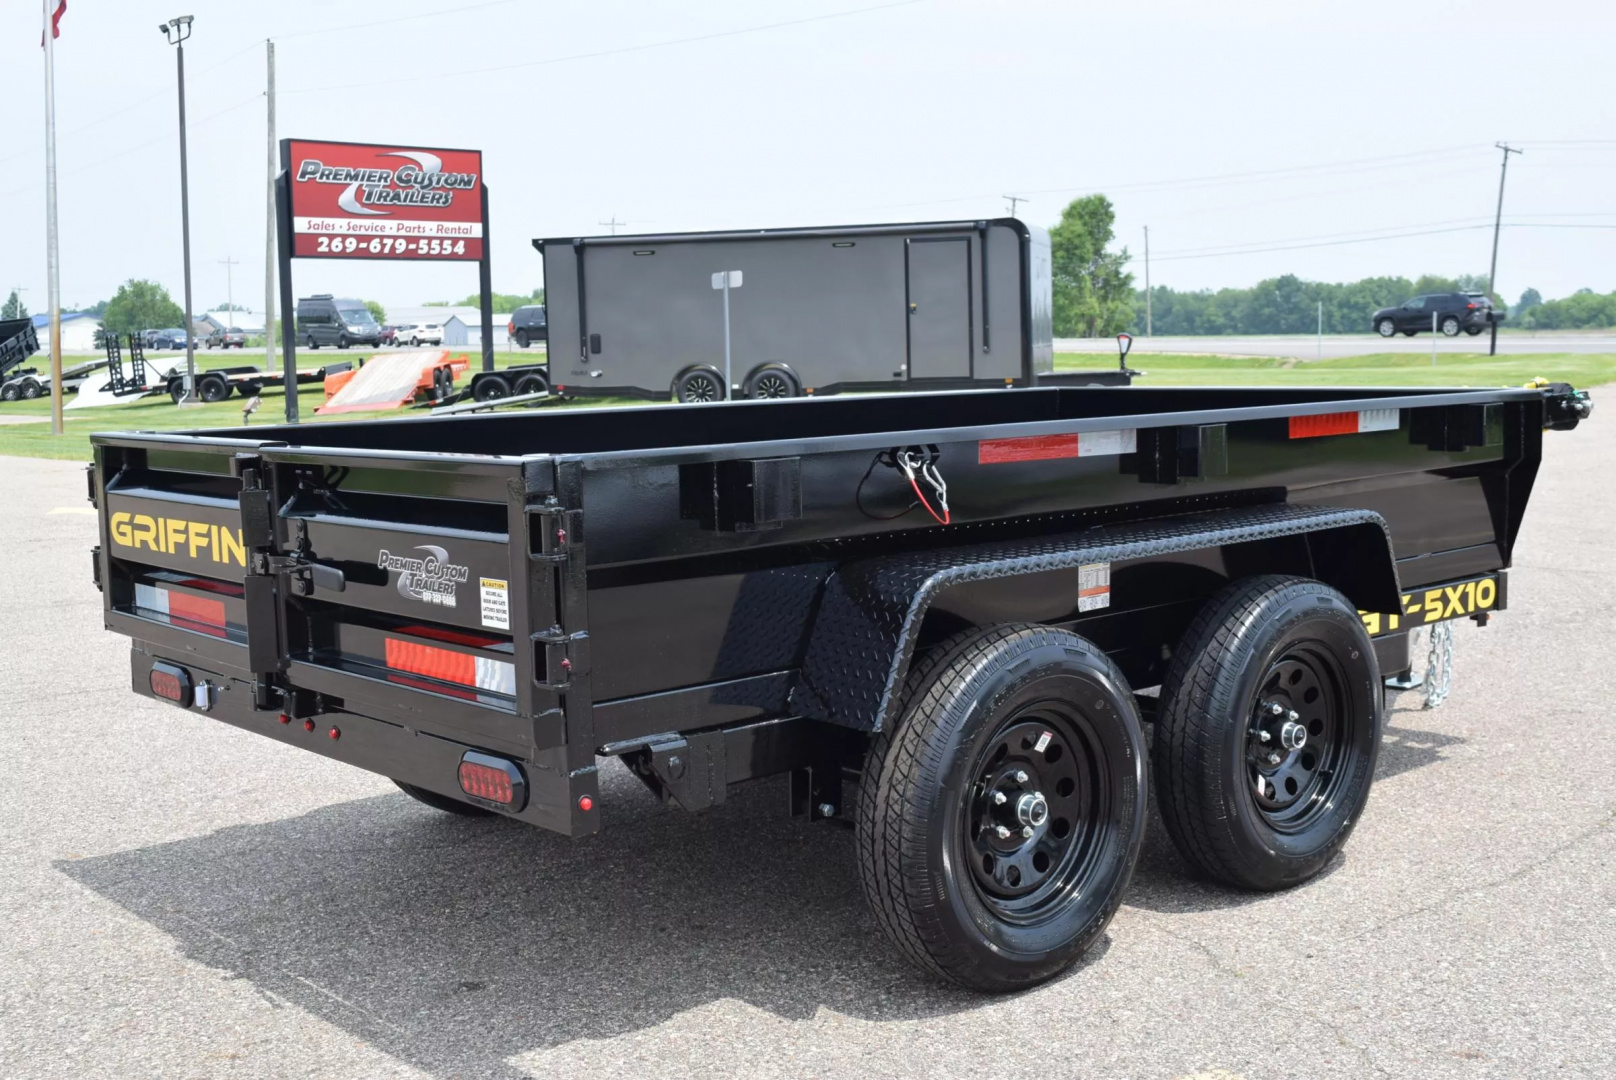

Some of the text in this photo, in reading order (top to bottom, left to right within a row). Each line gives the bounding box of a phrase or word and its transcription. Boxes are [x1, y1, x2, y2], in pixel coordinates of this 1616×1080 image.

[297, 160, 476, 190] PREMIER CUSTOM
[362, 184, 452, 206] TRAILERS
[307, 220, 473, 235] Sales Service Parts Rental
[317, 236, 465, 255] 269-679-5554
[110, 511, 246, 567] GRIFFIN
[378, 549, 468, 583] PREMIER CUSTOM
[407, 572, 456, 595] TRAILERS
